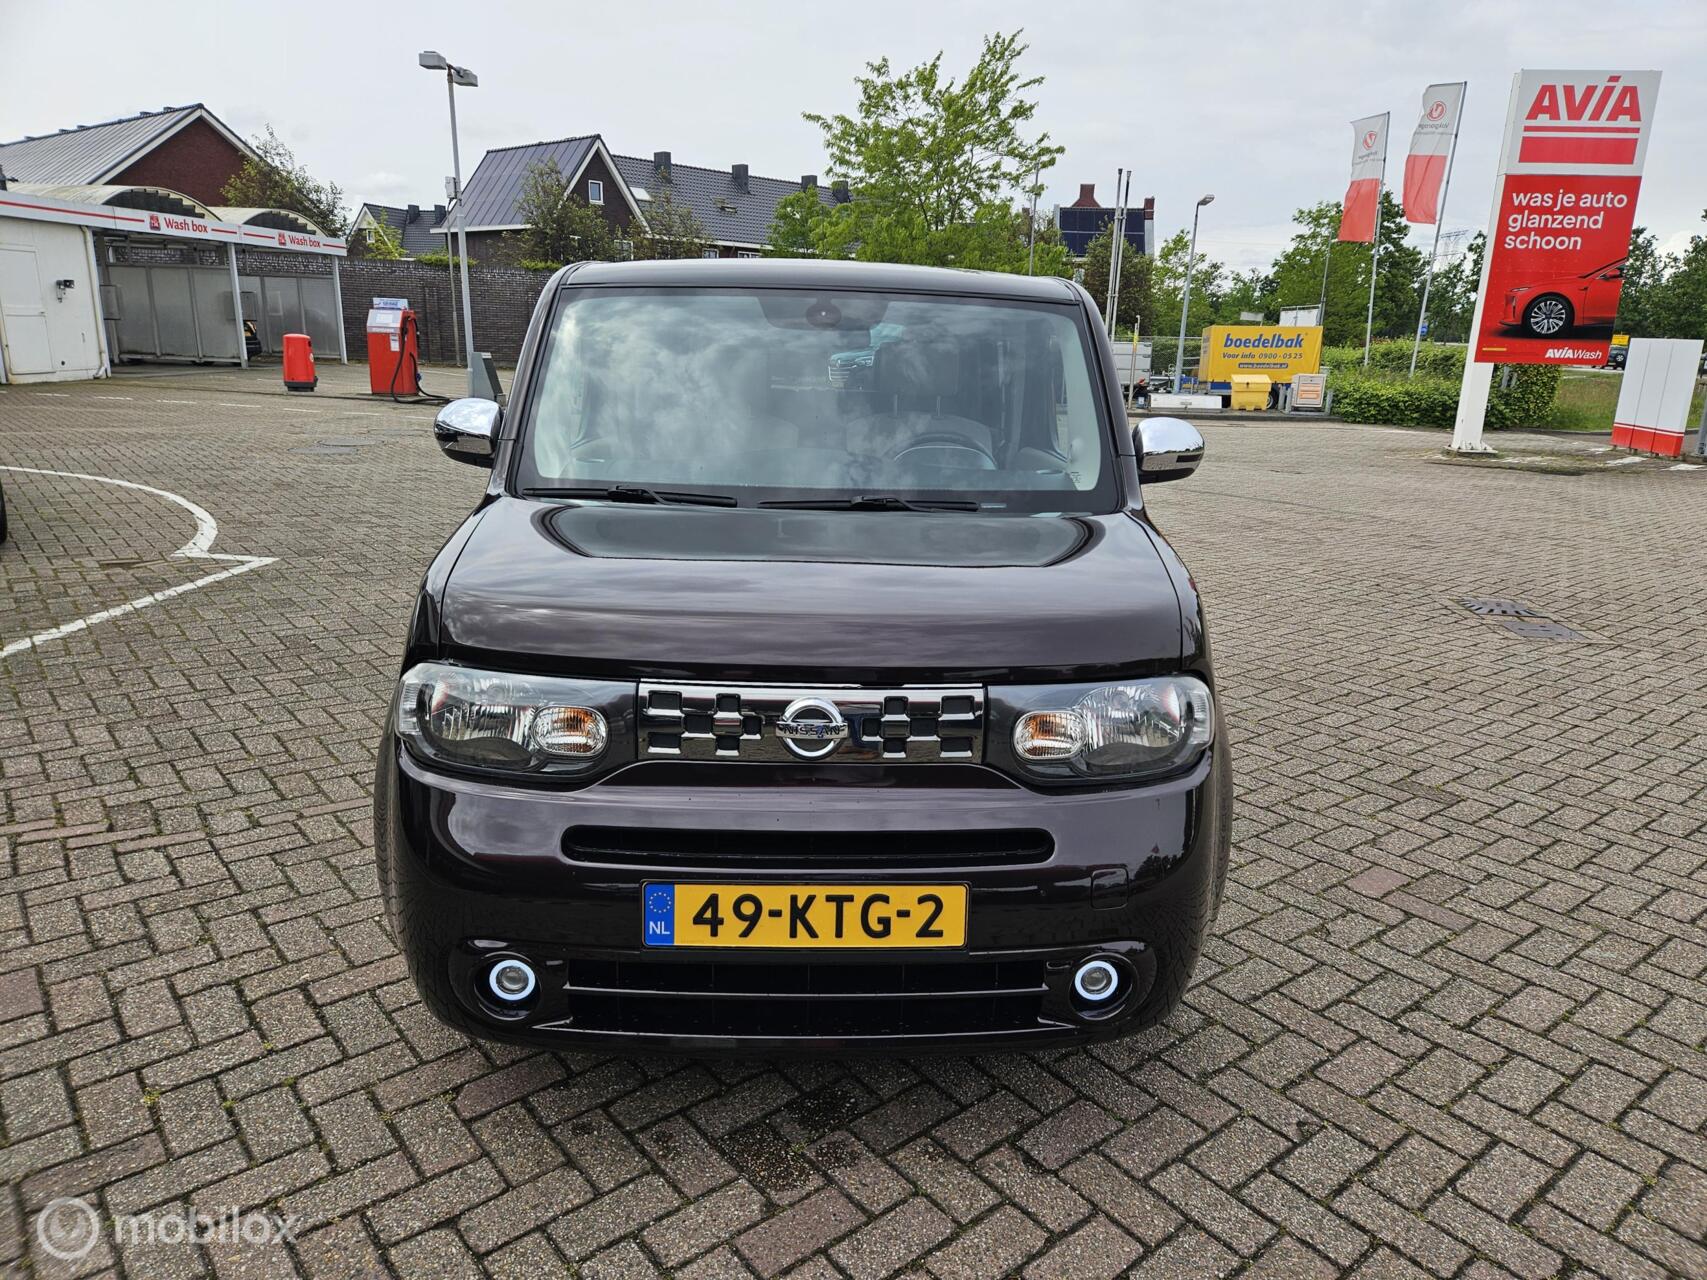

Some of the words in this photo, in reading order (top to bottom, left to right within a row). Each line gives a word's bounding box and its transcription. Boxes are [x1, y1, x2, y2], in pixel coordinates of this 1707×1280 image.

[1525, 75, 1642, 121] AVIA
[1512, 192, 1553, 207] was
[1553, 189, 1576, 211] je
[1579, 191, 1628, 208] auto
[164, 217, 190, 231] Wash
[191, 220, 208, 233] box
[1508, 210, 1604, 232] glanzend
[288, 235, 308, 246] Wash
[308, 237, 321, 248] box
[1504, 231, 1582, 250] schoon
[1224, 333, 1303, 348] boedelbak
[783, 724, 841, 736] NISSAN
[692, 893, 944, 939] 49-KTG-2
[649, 921, 671, 935] NL
